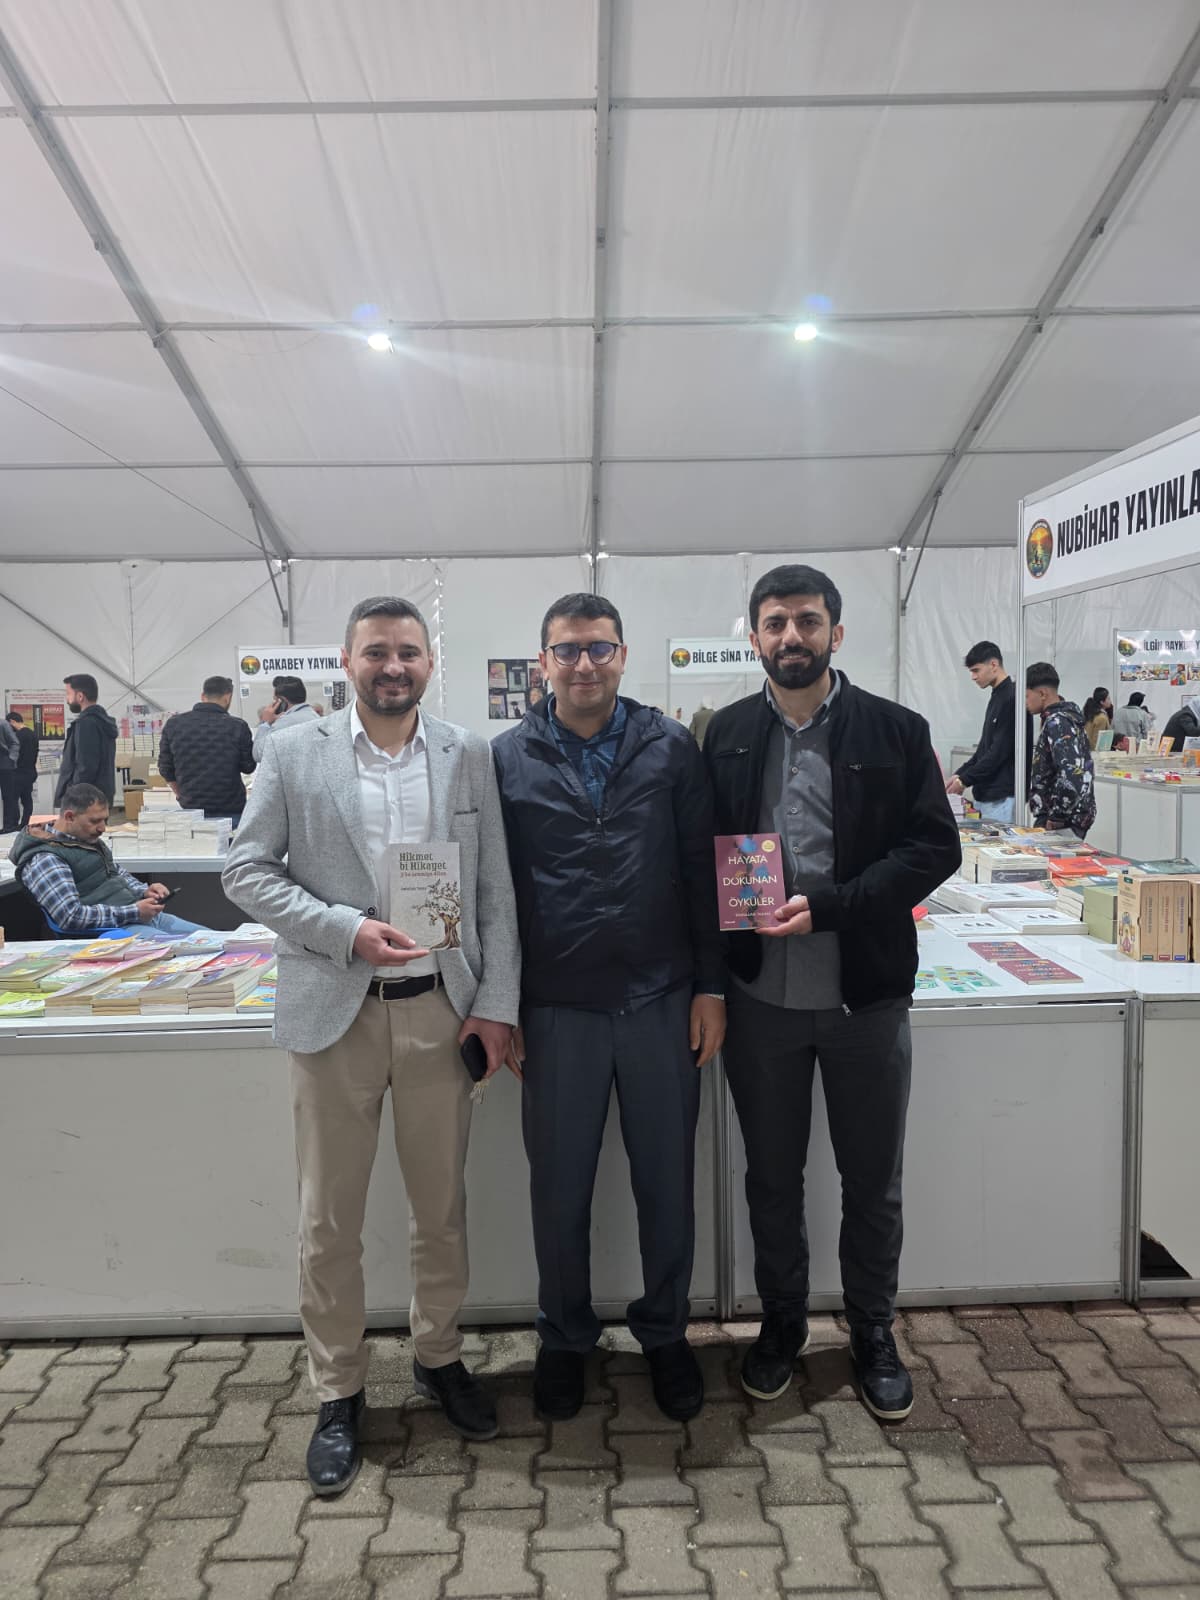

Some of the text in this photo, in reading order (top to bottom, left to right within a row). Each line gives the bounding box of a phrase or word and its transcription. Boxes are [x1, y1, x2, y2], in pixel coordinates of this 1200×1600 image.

[1056, 503, 1120, 558] NUBİHAR
[692, 648, 718, 664] BİLGE
[720, 648, 742, 663] SİNA
[262, 658, 305, 675] ÇAKABEY
[727, 854, 769, 865] HAYATA
[722, 874, 778, 886] DOKUNAN
[728, 896, 776, 907] ÖYKÜLER
